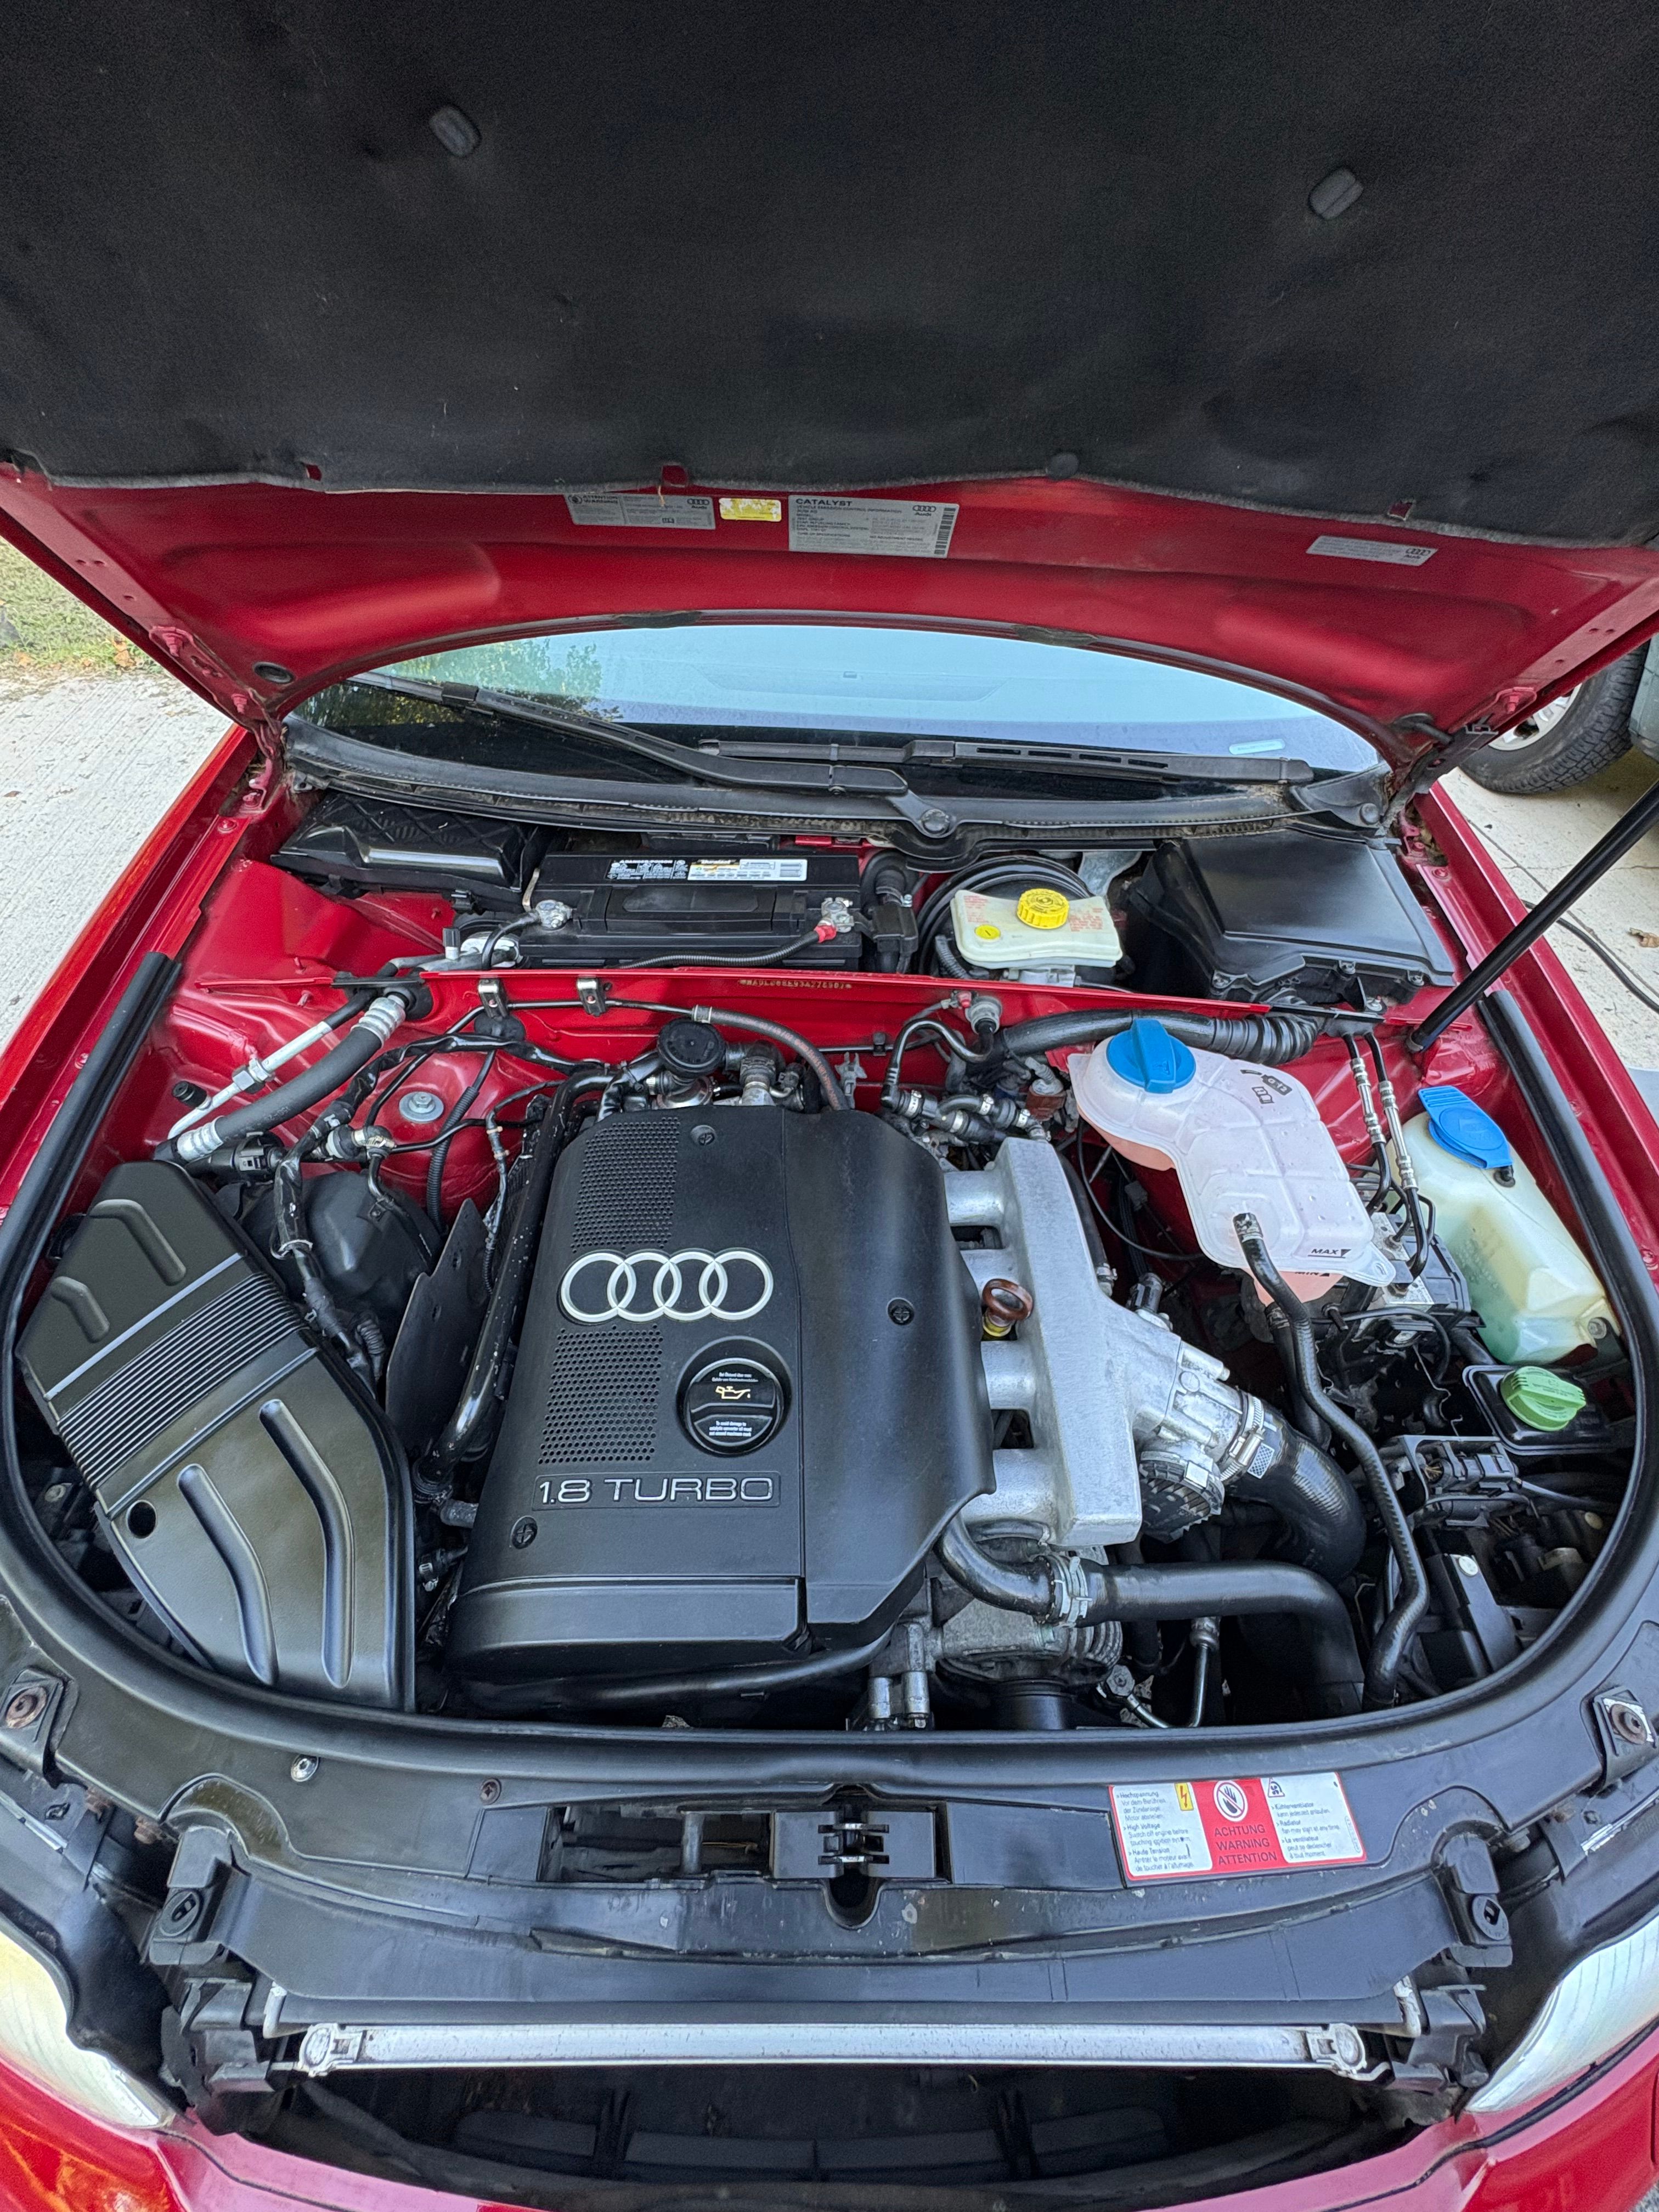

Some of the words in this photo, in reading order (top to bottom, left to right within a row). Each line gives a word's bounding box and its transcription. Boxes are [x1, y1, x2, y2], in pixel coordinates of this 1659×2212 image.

[795, 498, 852, 506] CATALYST
[539, 1479, 591, 1504] 1.8
[604, 1477, 772, 1502] TURBO
[1215, 1824, 1265, 1837] ACHTUNG
[1216, 1838, 1269, 1850] WARNING
[1219, 1851, 1277, 1865] ATTENTION
